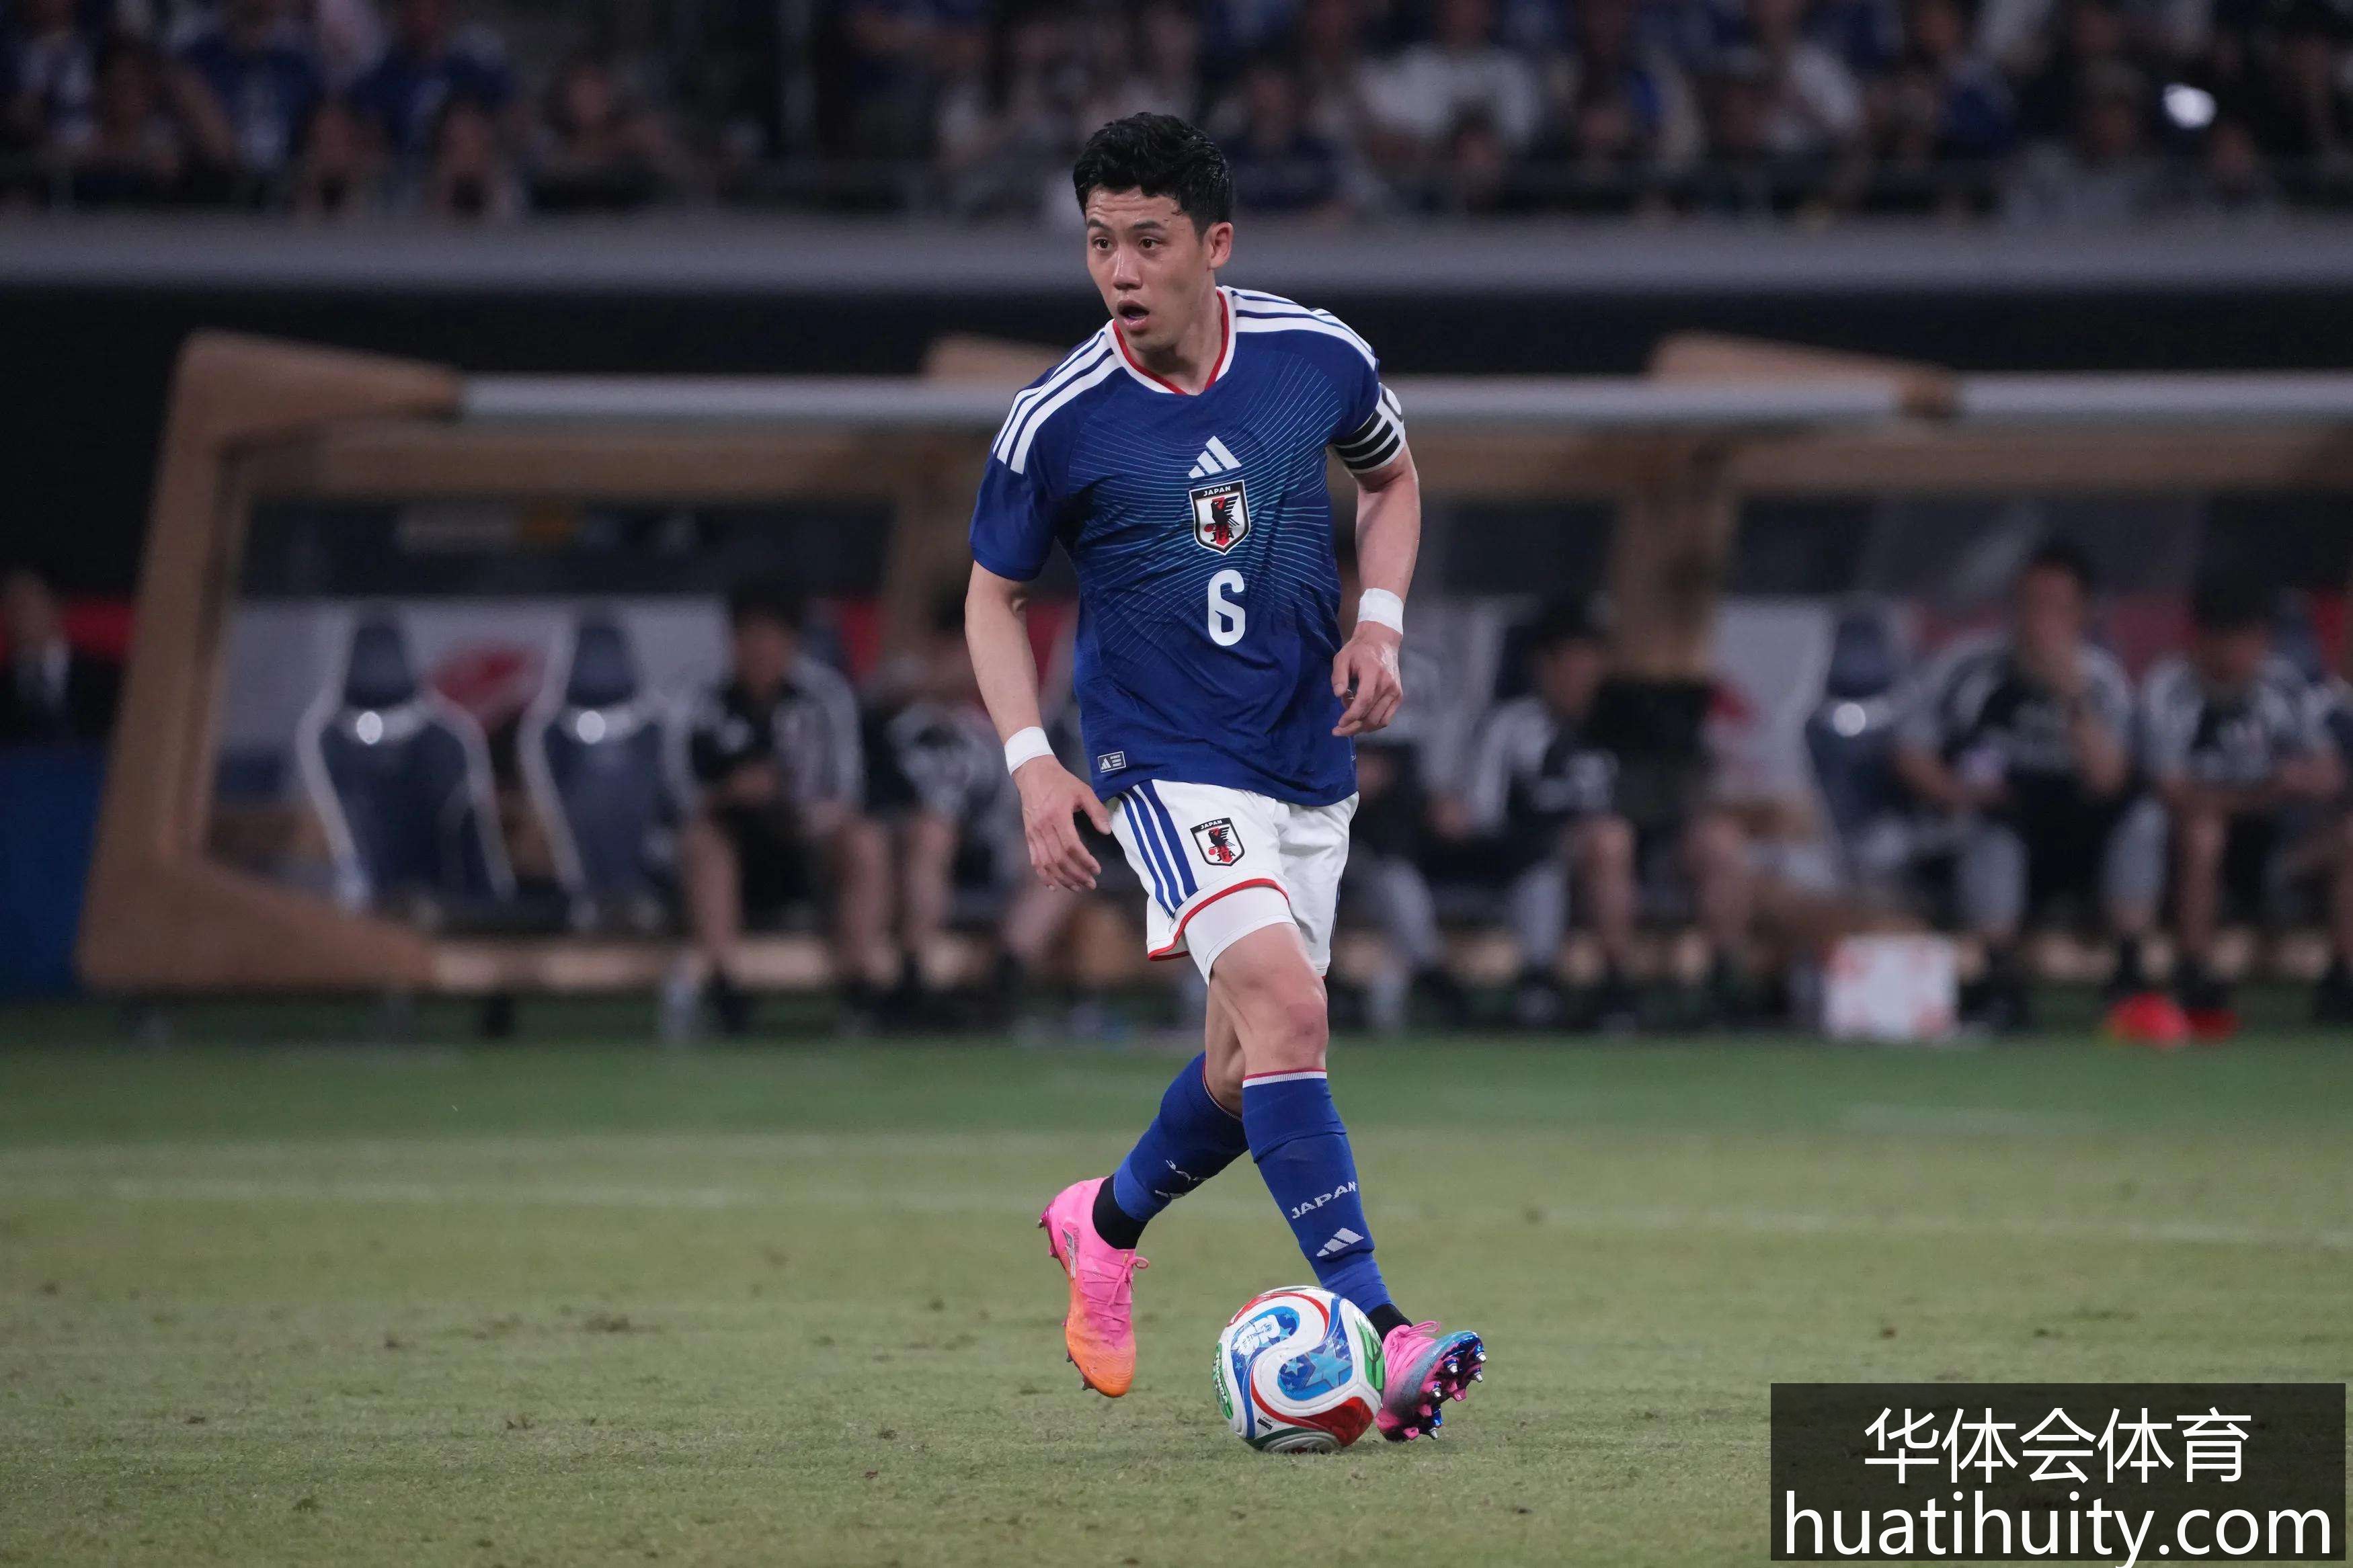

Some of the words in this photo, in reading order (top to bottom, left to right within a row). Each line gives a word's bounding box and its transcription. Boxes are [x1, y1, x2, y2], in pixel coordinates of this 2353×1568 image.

[1203, 485, 1231, 497] JAPAN
[1207, 569, 1246, 646] 6
[1201, 819, 1222, 830] JAPAN
[1291, 1182, 1356, 1219] JAPAN
